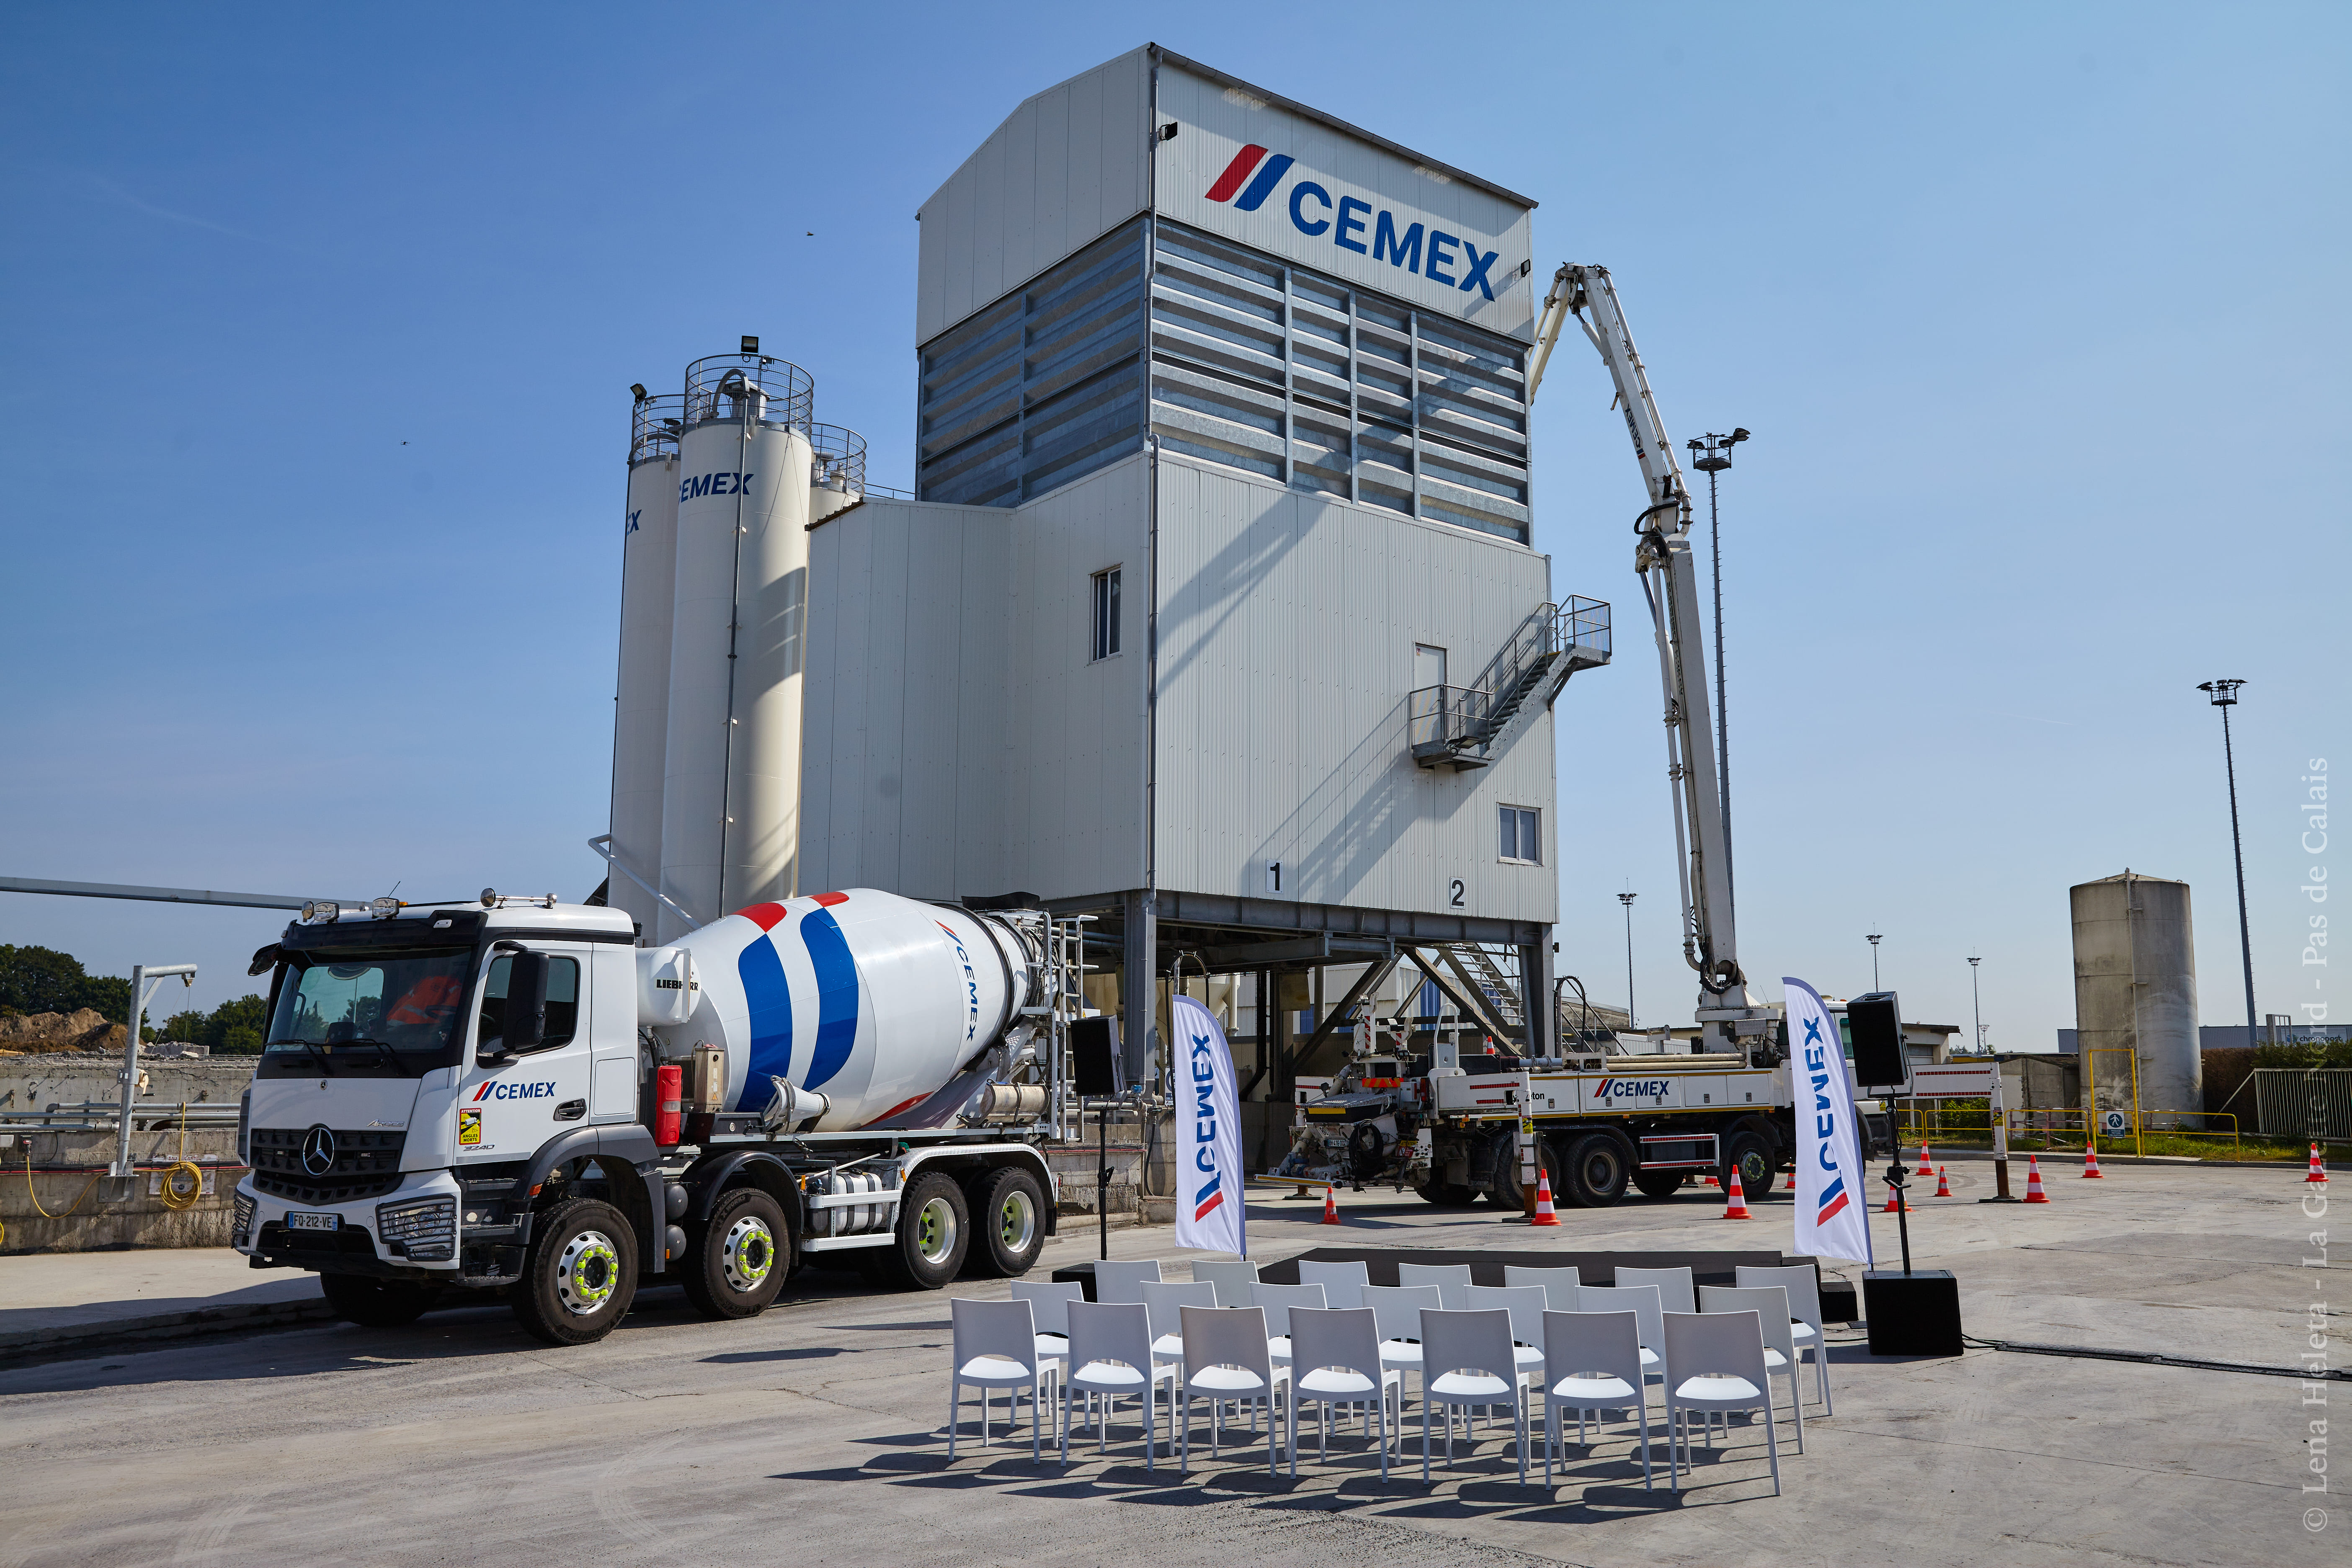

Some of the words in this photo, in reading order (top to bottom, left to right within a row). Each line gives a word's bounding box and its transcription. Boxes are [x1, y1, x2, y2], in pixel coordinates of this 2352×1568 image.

[1289, 181, 1499, 302] CEMEX
[1625, 403, 1641, 448] CEMEX
[1270, 862, 1280, 891] 1
[1451, 879, 1465, 906] 2
[656, 979, 698, 991] LIEBHRR
[957, 946, 978, 1042] CEMEX
[495, 1081, 557, 1100] CEMEX
[1192, 1034, 1216, 1172] CEMEX
[1614, 1081, 1670, 1097] CEMEX
[1803, 1016, 1838, 1171] CEMEX
[294, 1215, 332, 1228] FQ-212-VE
